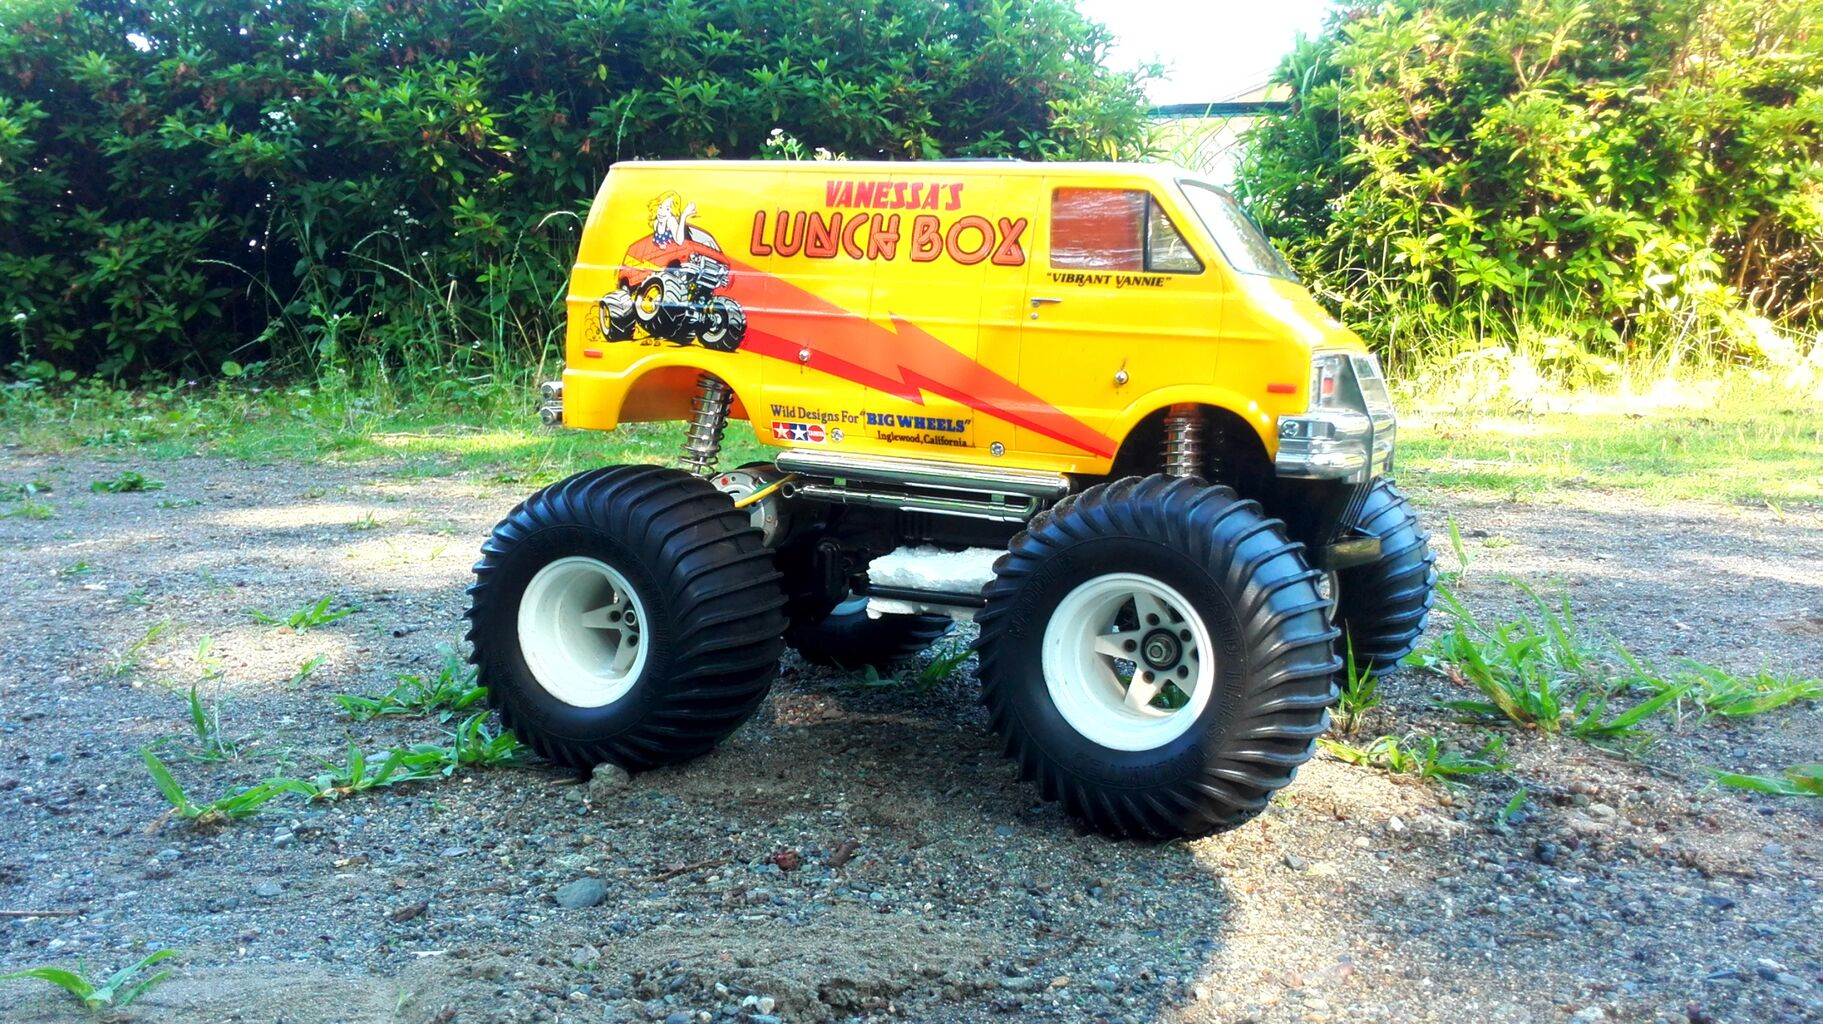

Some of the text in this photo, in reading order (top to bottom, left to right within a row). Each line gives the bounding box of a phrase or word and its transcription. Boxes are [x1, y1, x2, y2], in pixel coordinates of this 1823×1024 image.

[825, 180, 964, 211] VANESSA'S
[750, 209, 1028, 266] LUNCH BOX
[1046, 272, 1172, 289] "VIBRANT VANNIE"
[770, 404, 971, 432] Wild Designs For "BIG WHEELS"
